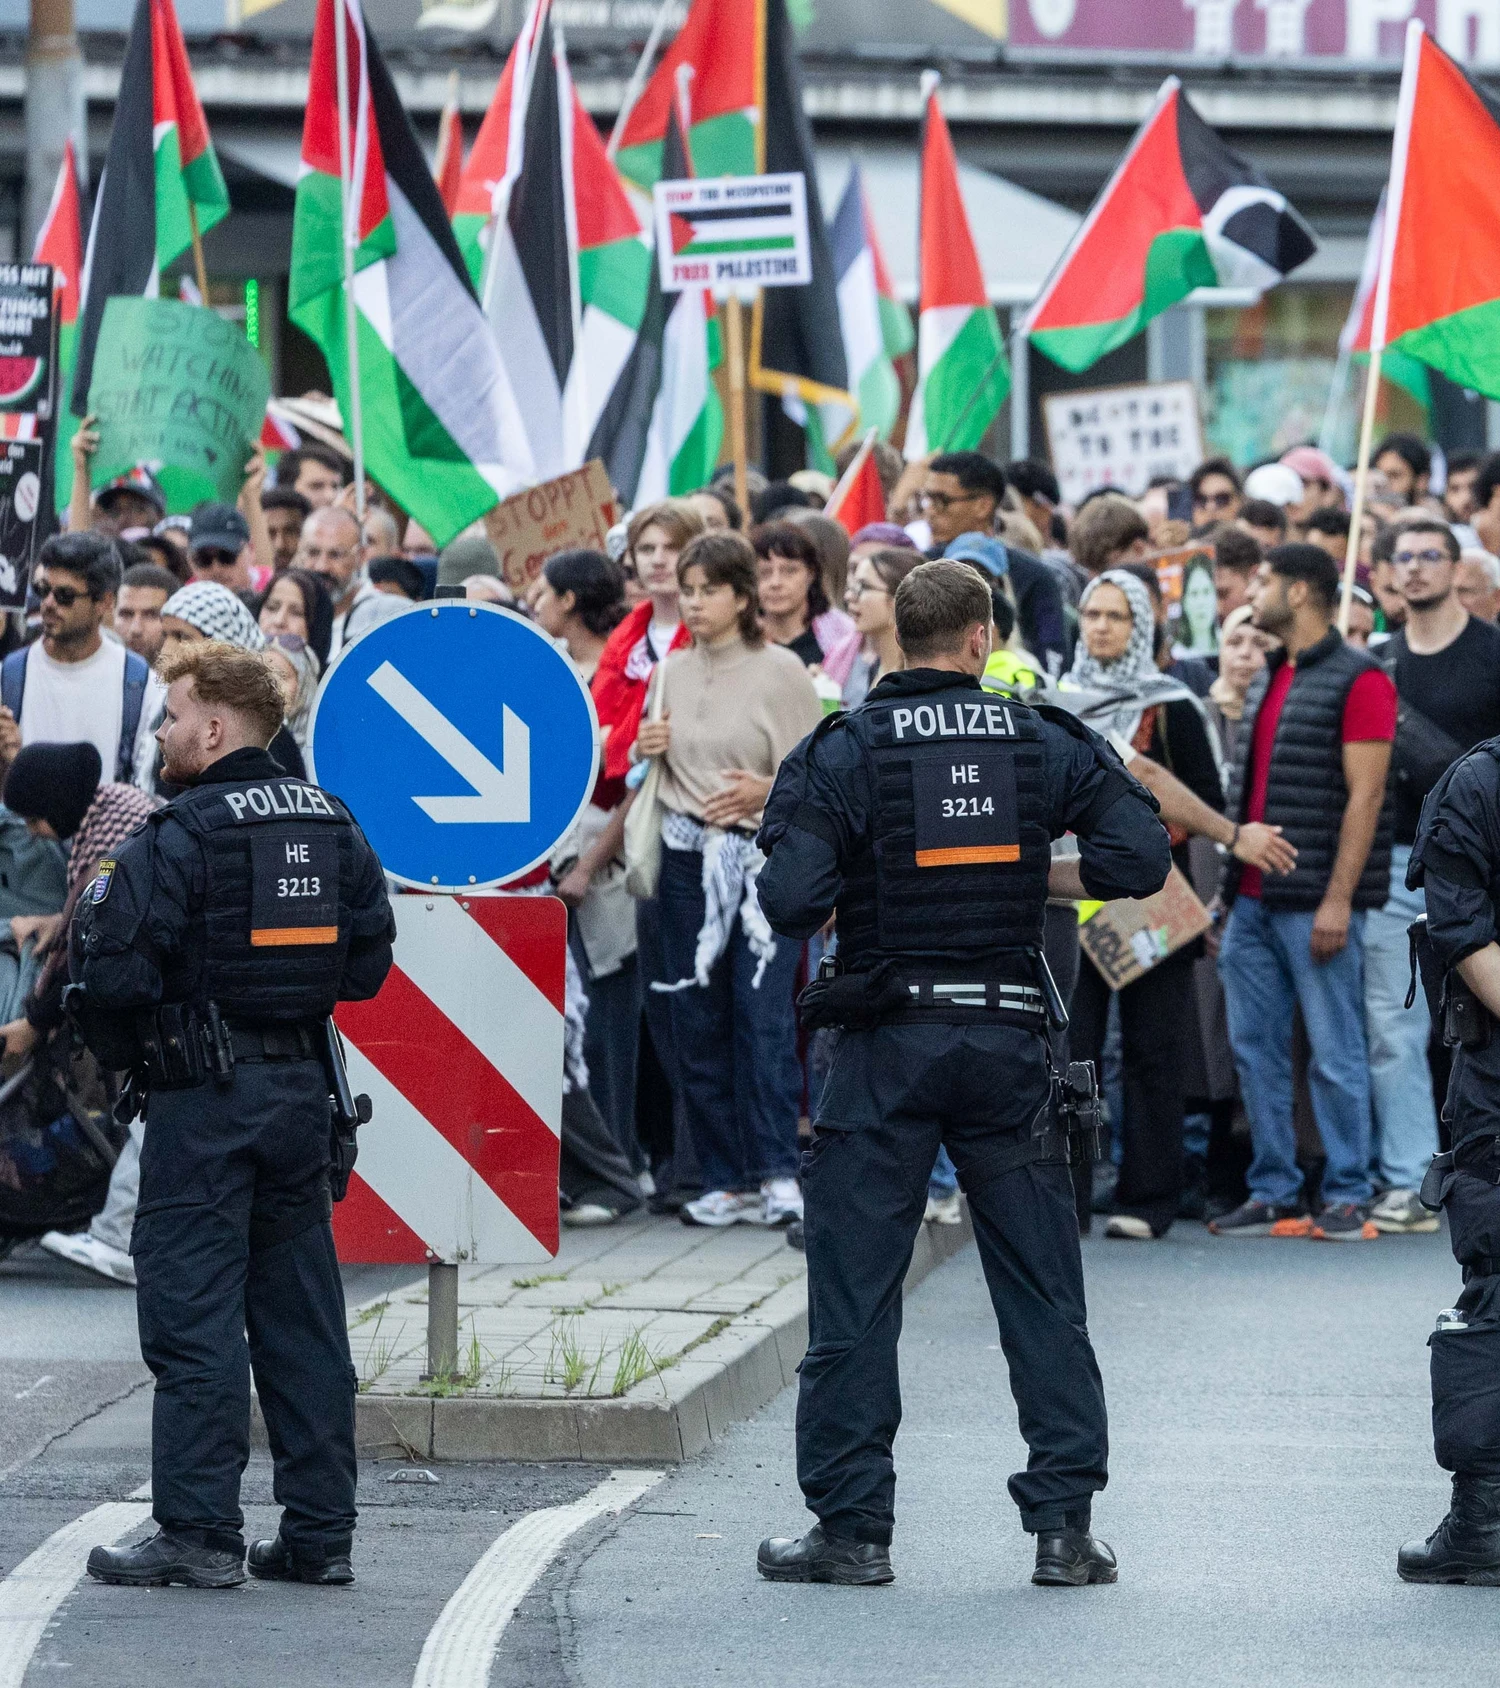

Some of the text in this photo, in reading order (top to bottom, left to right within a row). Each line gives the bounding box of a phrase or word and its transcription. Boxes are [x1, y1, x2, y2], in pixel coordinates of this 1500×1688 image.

[672, 256, 798, 282] FREE PALESTINE
[892, 703, 1016, 739] POLIZEI
[951, 764, 980, 785] HE
[225, 785, 336, 820] POLIZEI
[941, 797, 995, 818] 3214
[285, 841, 311, 864] HE
[277, 877, 321, 898] 3213
